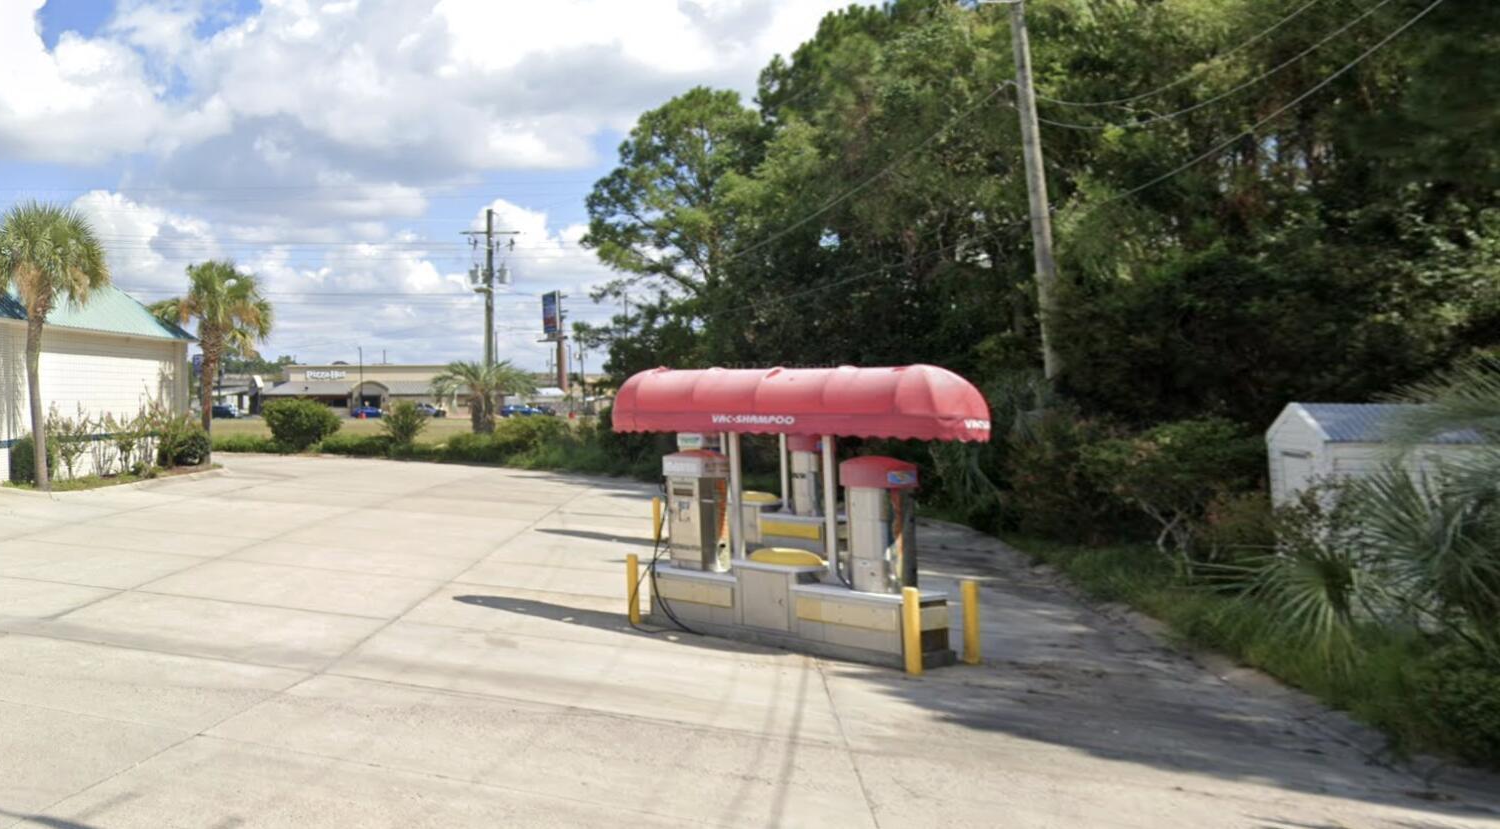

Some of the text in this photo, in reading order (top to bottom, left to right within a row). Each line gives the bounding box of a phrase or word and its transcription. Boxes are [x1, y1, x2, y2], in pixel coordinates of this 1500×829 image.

[306, 370, 346, 380] Pizza Hut
[711, 413, 795, 425] VAC-SHAMPOO
